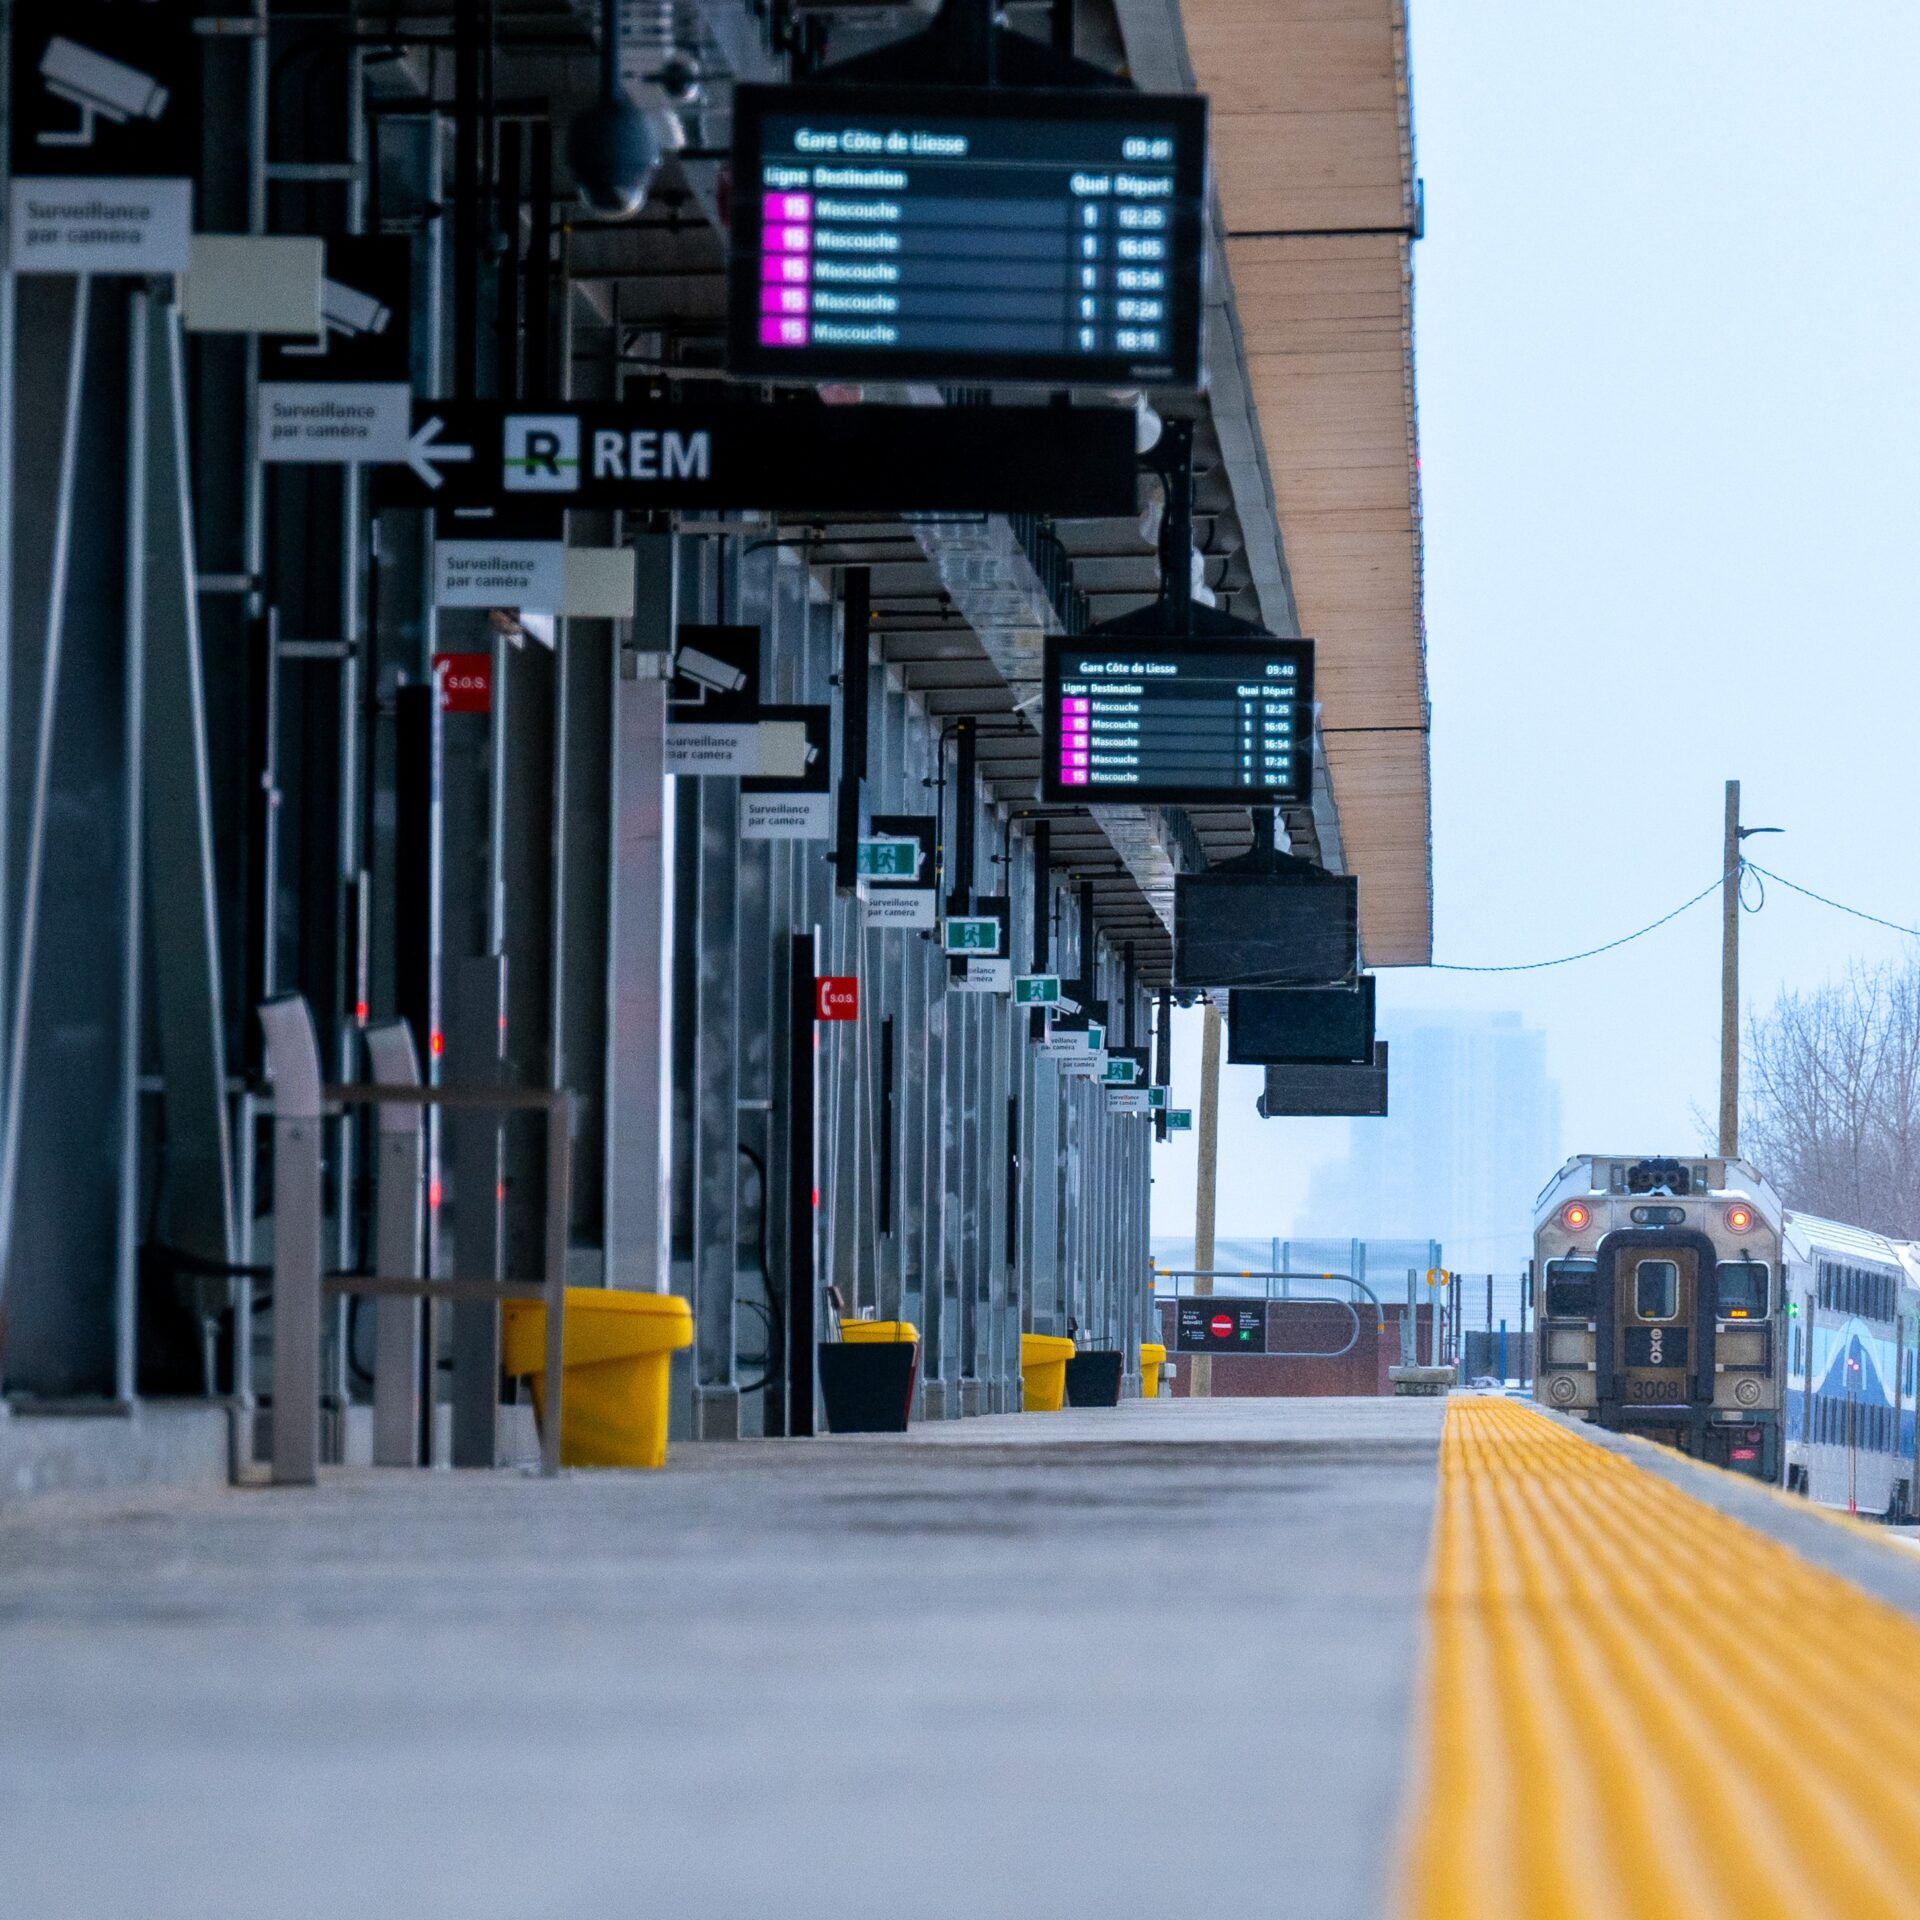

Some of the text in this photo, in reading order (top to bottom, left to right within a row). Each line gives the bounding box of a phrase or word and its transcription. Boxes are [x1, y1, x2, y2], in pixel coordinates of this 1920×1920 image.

[796, 130, 966, 154] Gare Côte de Liesse
[765, 167, 1173, 197] Ligne Destination Quai Départ
[27, 202, 150, 220] Surveillance
[784, 197, 1164, 228] 15 Mascouche 1 12:25
[27, 226, 142, 246] par caméra
[783, 227, 1164, 259] 15 Mascouche 1 16:05
[782, 257, 1163, 289] 15 Mascouche 1 16:54
[782, 288, 1162, 320] 15 Mascouche 1 17:24
[781, 319, 1159, 351] 15 Mascouche 1 18:11
[272, 402, 375, 418] Surveillance
[272, 422, 368, 440] par caméra
[593, 430, 711, 479] REM
[446, 557, 535, 571] Surveillance
[446, 574, 528, 589] par caméra
[1080, 662, 1177, 675] Gare Côte de Liesse
[1265, 664, 1295, 676] 09:40
[448, 676, 487, 689] S.O.S.
[1062, 683, 1294, 698] Ligne Destination Quai Départ
[1074, 700, 1087, 712] 15
[1092, 702, 1139, 712] Mascouche
[1265, 704, 1289, 714] 12:25
[1074, 718, 1086, 729] 15
[1091, 719, 1139, 729] Mascouche
[1264, 722, 1289, 732] 16:05
[1074, 735, 1086, 746] 15
[1091, 737, 1138, 747] Mascouche
[1264, 739, 1289, 749] 16:54
[691, 750, 732, 760] caméra
[1073, 753, 1086, 764] 15
[1091, 754, 1138, 764] Mascouche
[1264, 756, 1288, 766] 17:24
[1073, 770, 1086, 781] 15
[1090, 772, 1138, 782] Mascouche
[1264, 773, 1288, 784] 18:11
[748, 804, 810, 814] Surveillance
[748, 816, 805, 827] par caméra
[868, 908, 915, 917] par caméra
[830, 993, 854, 1003] S.O.S.
[1650, 1328, 1663, 1365] exo
[1633, 1381, 1680, 1399] 3008
